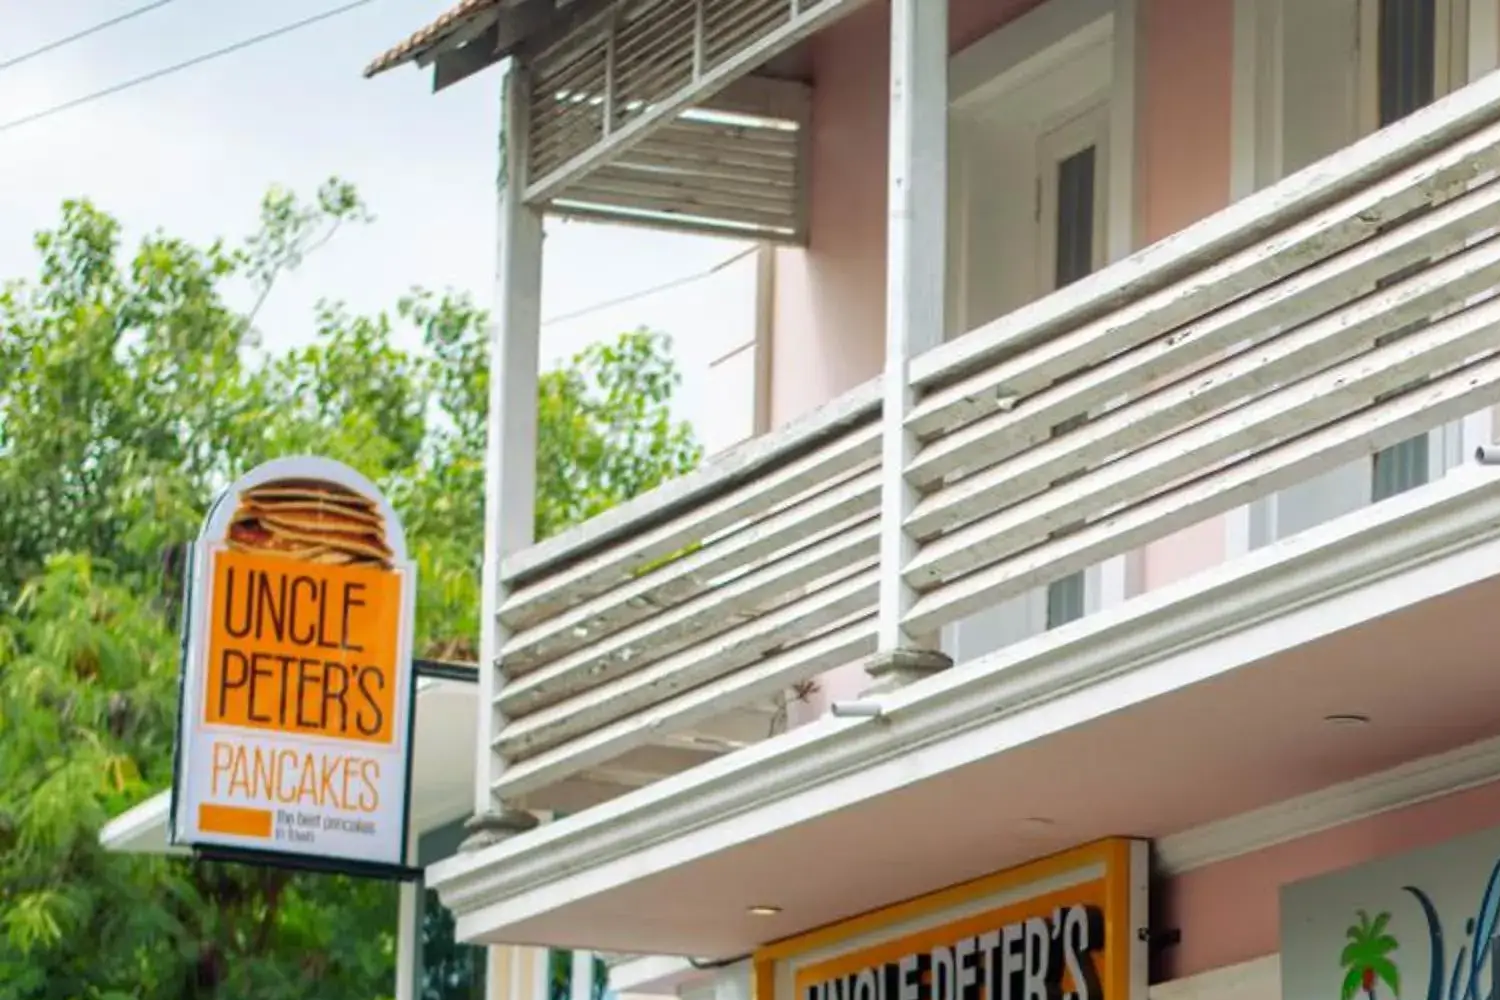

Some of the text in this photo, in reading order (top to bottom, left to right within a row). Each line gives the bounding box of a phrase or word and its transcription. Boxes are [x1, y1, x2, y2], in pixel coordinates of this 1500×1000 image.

[224, 567, 366, 652] UNCLE
[219, 648, 385, 737] PETER'S
[211, 741, 381, 813] PANCAKES
